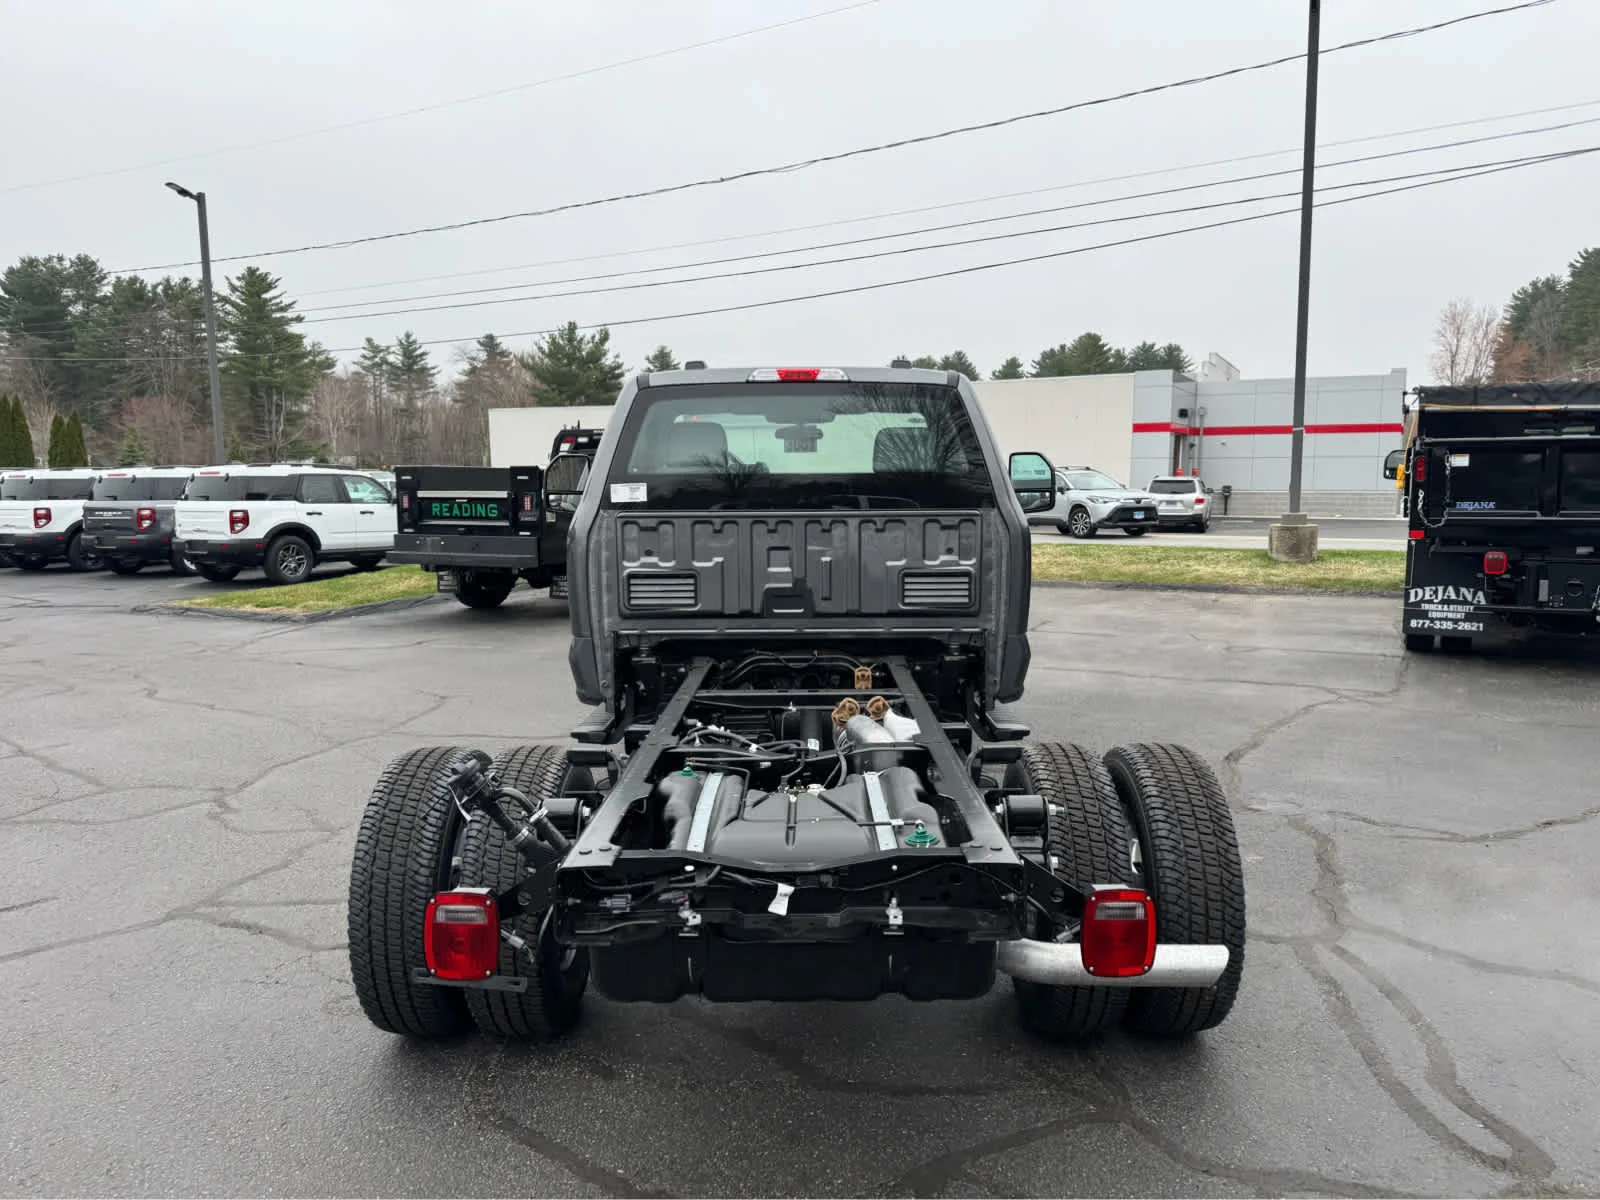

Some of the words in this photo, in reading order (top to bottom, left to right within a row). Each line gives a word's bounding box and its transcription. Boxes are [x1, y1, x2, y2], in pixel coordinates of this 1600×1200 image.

[431, 503, 498, 517] READING
[1455, 501, 1496, 511] DEJANA
[1407, 585, 1487, 605] DEJANA
[1428, 611, 1465, 619] EQUIPMENT
[1409, 619, 1484, 632] 877-335-2621
